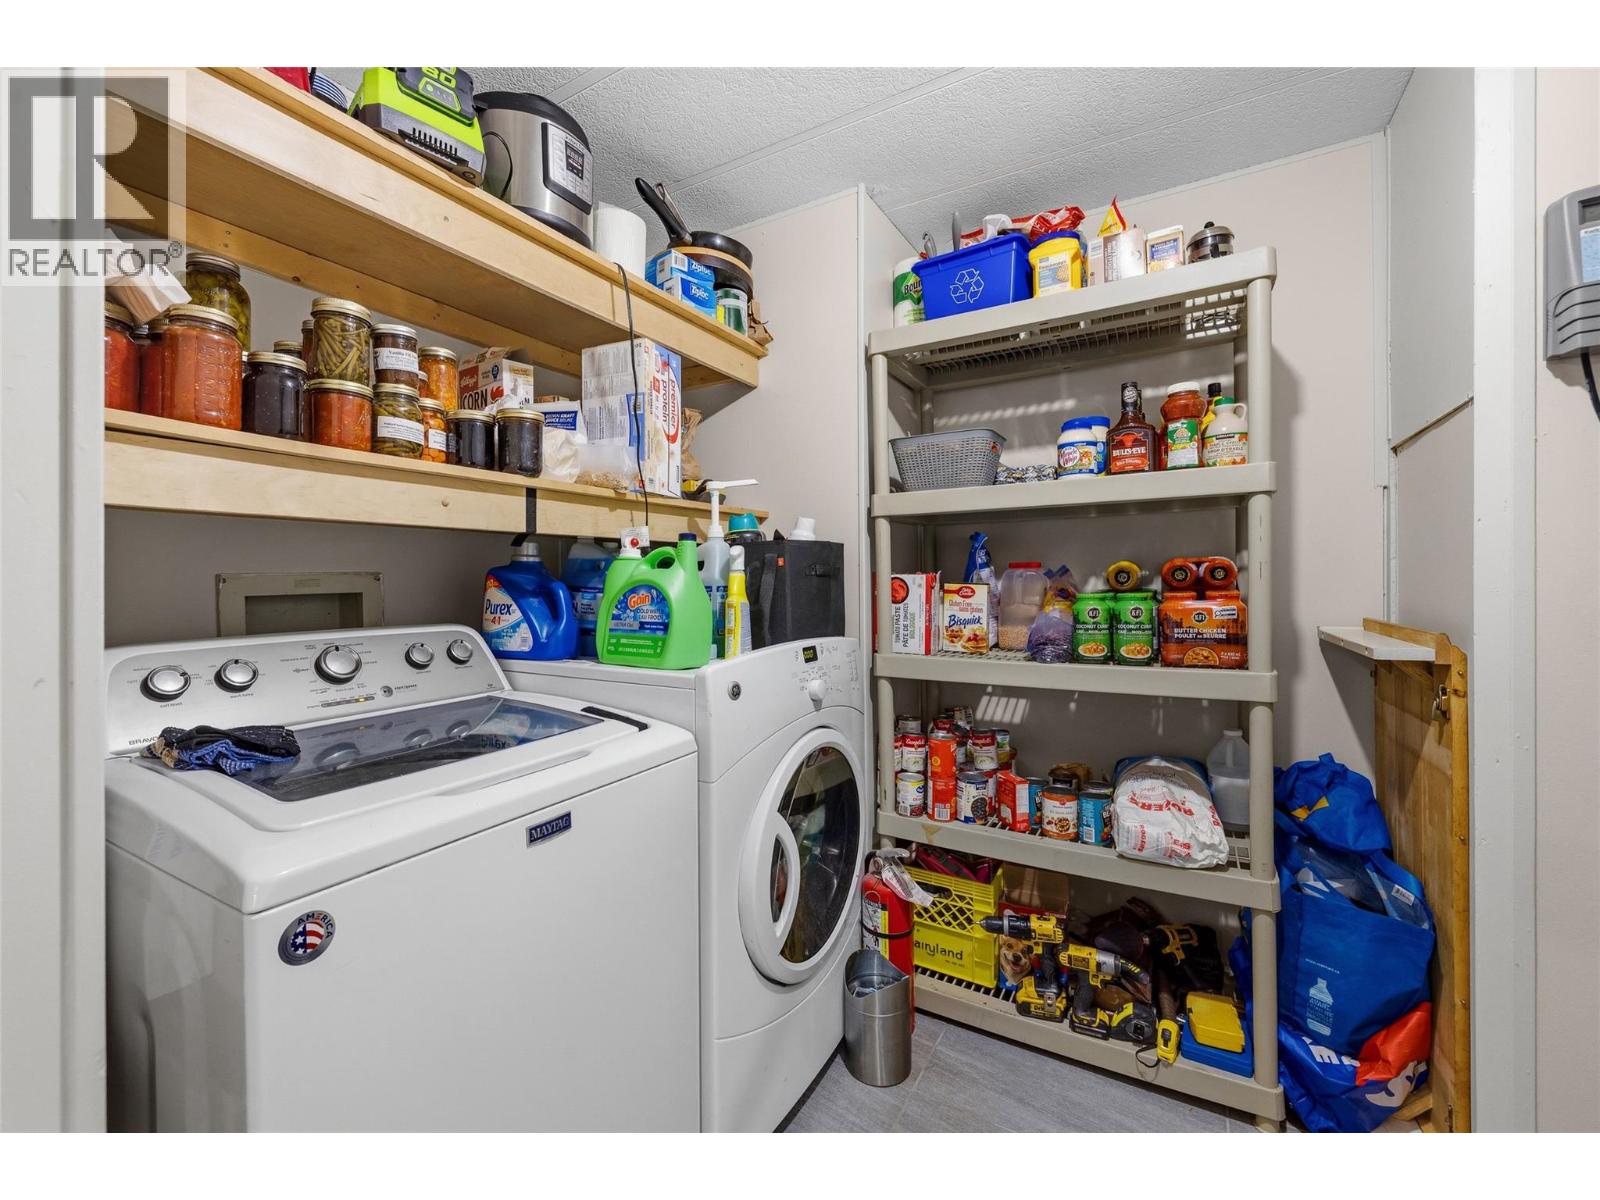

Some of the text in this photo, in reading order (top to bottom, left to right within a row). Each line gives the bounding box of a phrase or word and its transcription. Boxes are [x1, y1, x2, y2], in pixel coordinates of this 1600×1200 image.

[462, 388, 488, 410] CORN
[484, 599, 512, 615] Purex
[628, 593, 651, 609] Gain
[948, 615, 983, 628] Bisquick
[530, 815, 570, 841] MAYTAG
[297, 912, 331, 939] AMERICA
[914, 940, 963, 960] airyland
